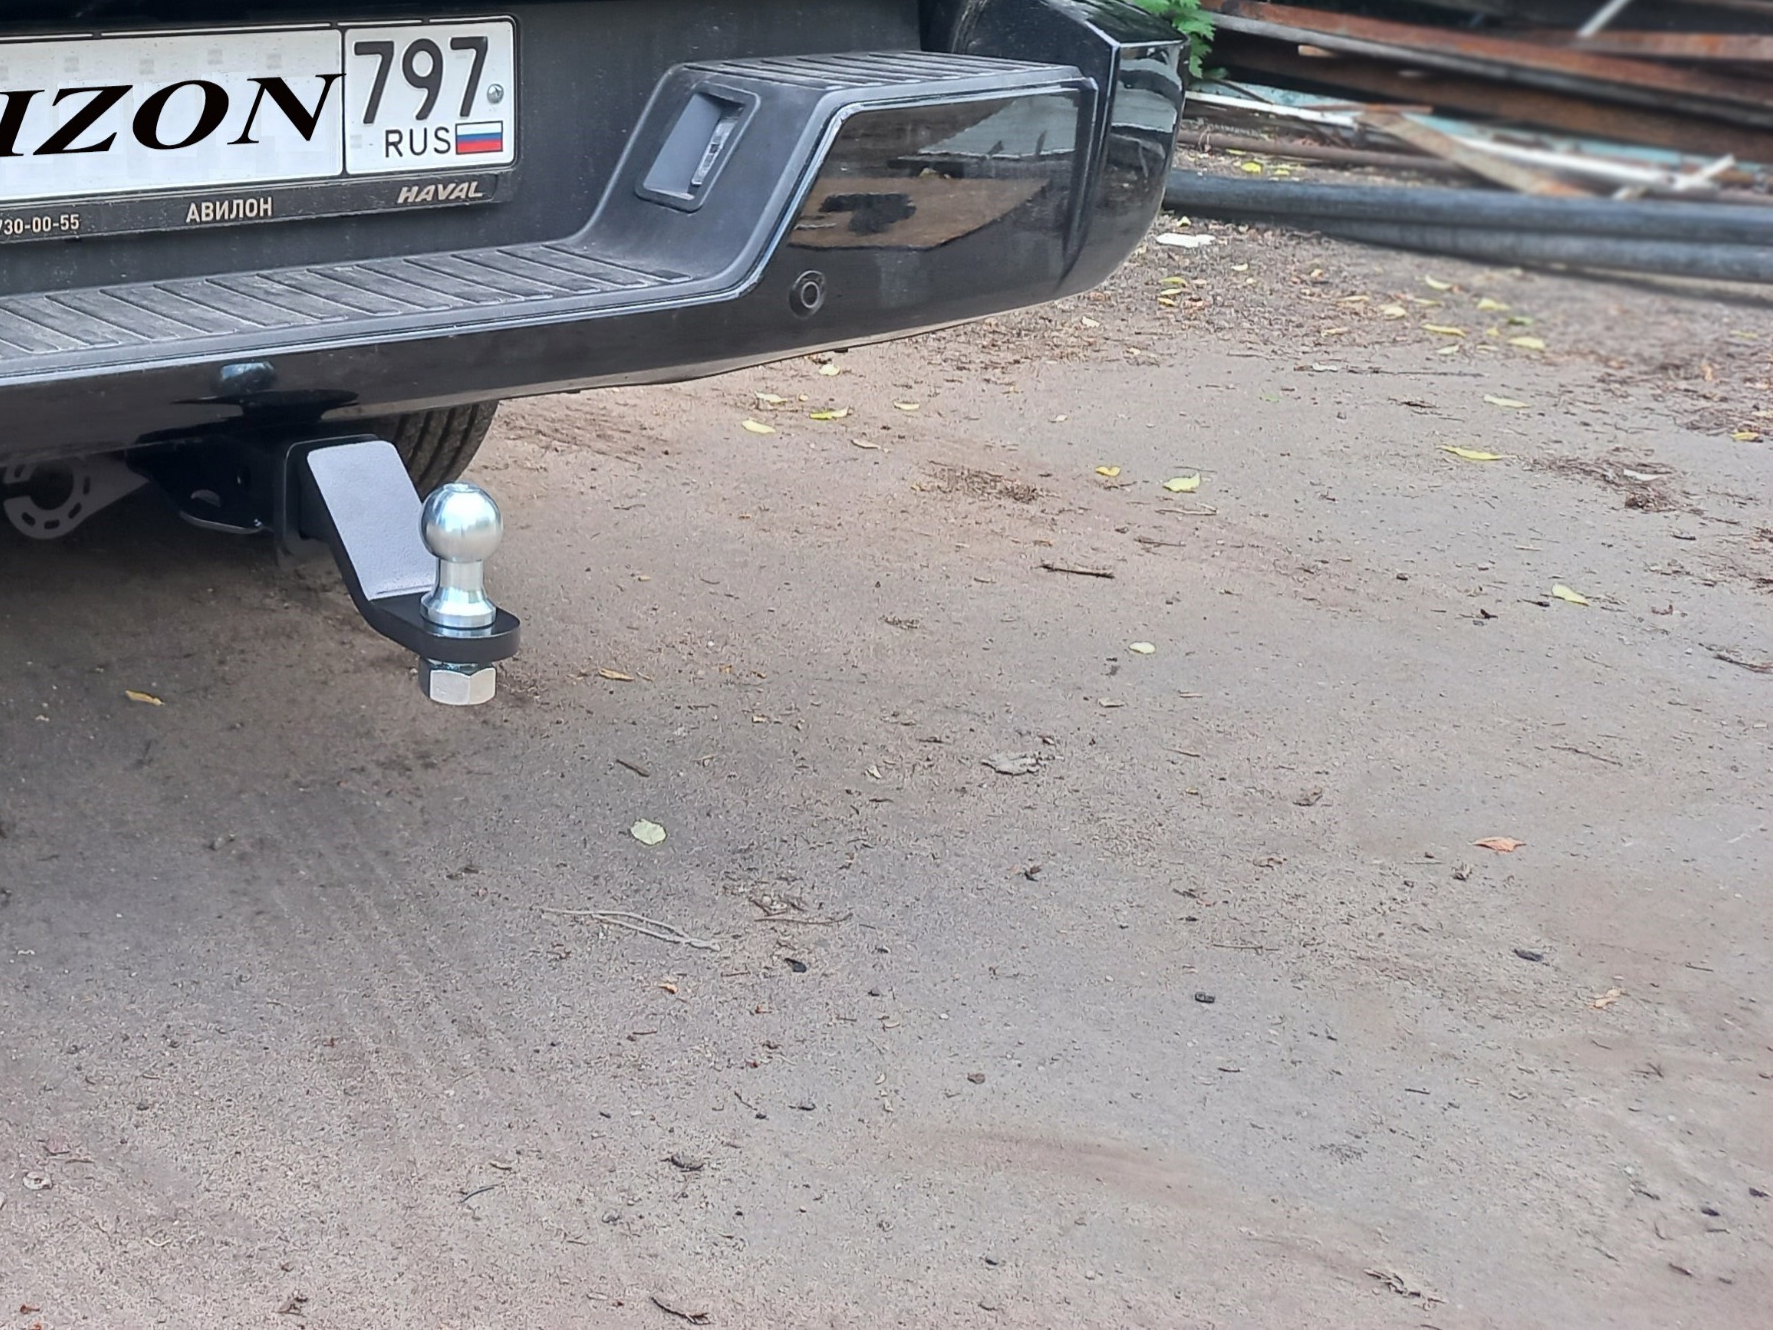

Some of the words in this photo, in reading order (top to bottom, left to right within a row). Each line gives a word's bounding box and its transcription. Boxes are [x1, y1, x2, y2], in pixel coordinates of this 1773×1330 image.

[353, 35, 489, 125] 797
[384, 126, 451, 158] RUS
[397, 181, 483, 204] HAVAL
[185, 196, 273, 223] АВИЛОН
